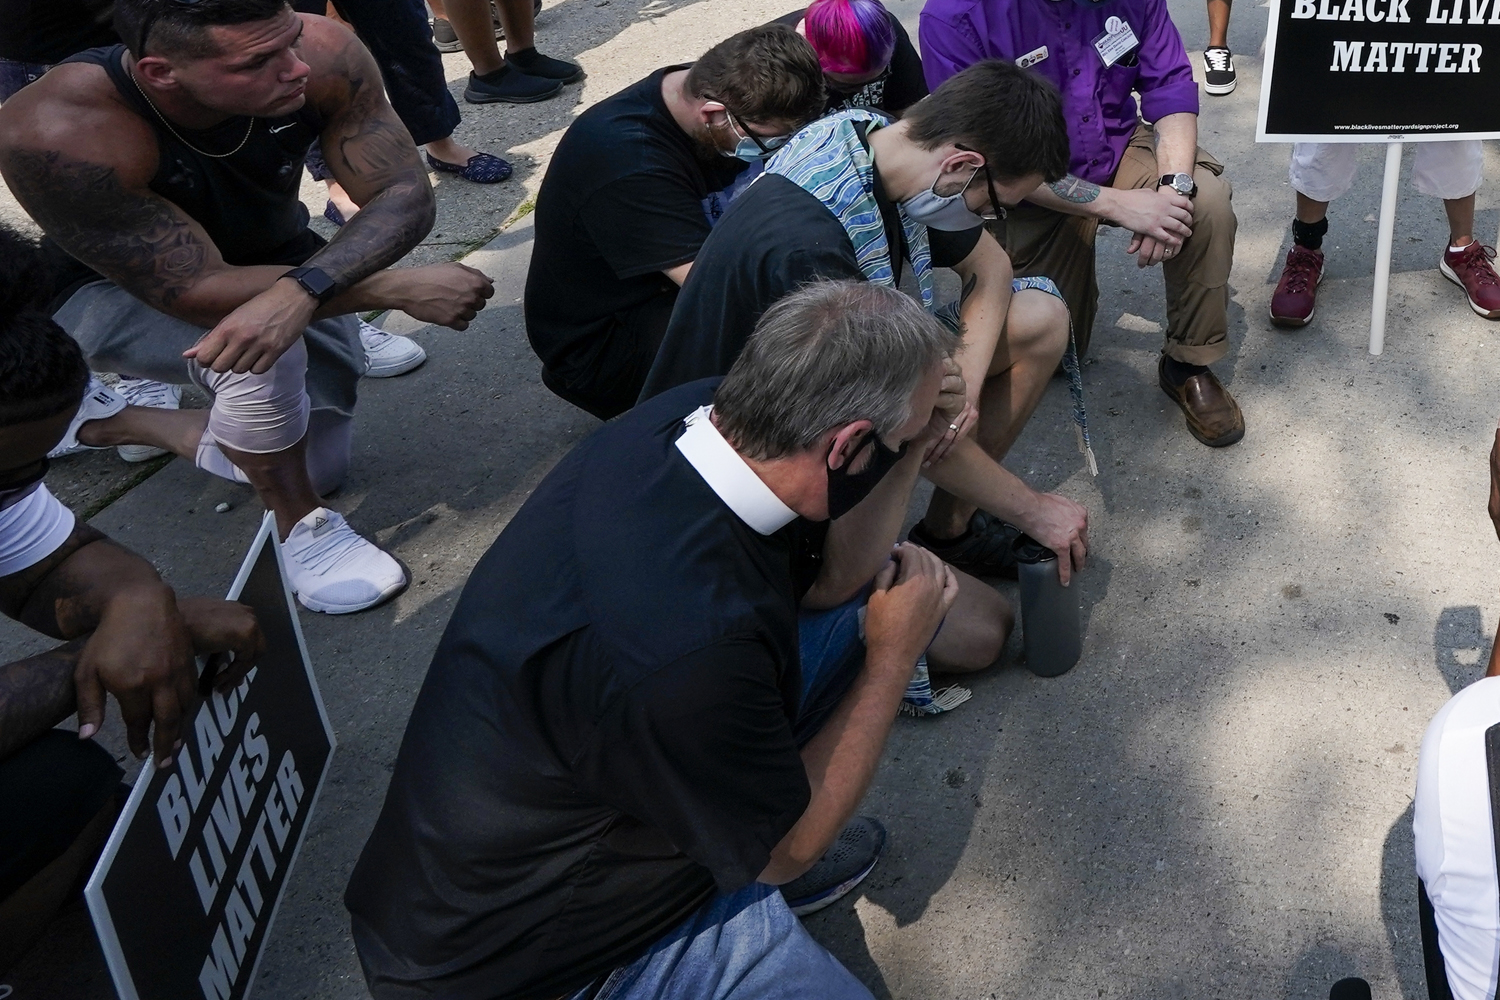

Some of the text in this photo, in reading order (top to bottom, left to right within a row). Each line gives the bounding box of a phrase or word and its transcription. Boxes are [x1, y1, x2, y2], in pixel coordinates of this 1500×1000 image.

[1329, 41, 1483, 73] MATTER
[1334, 123, 1460, 131] www.blacklivesmatteryardsignproject.org
[189, 711, 270, 916] LIVES
[198, 749, 305, 1000] MATTER
